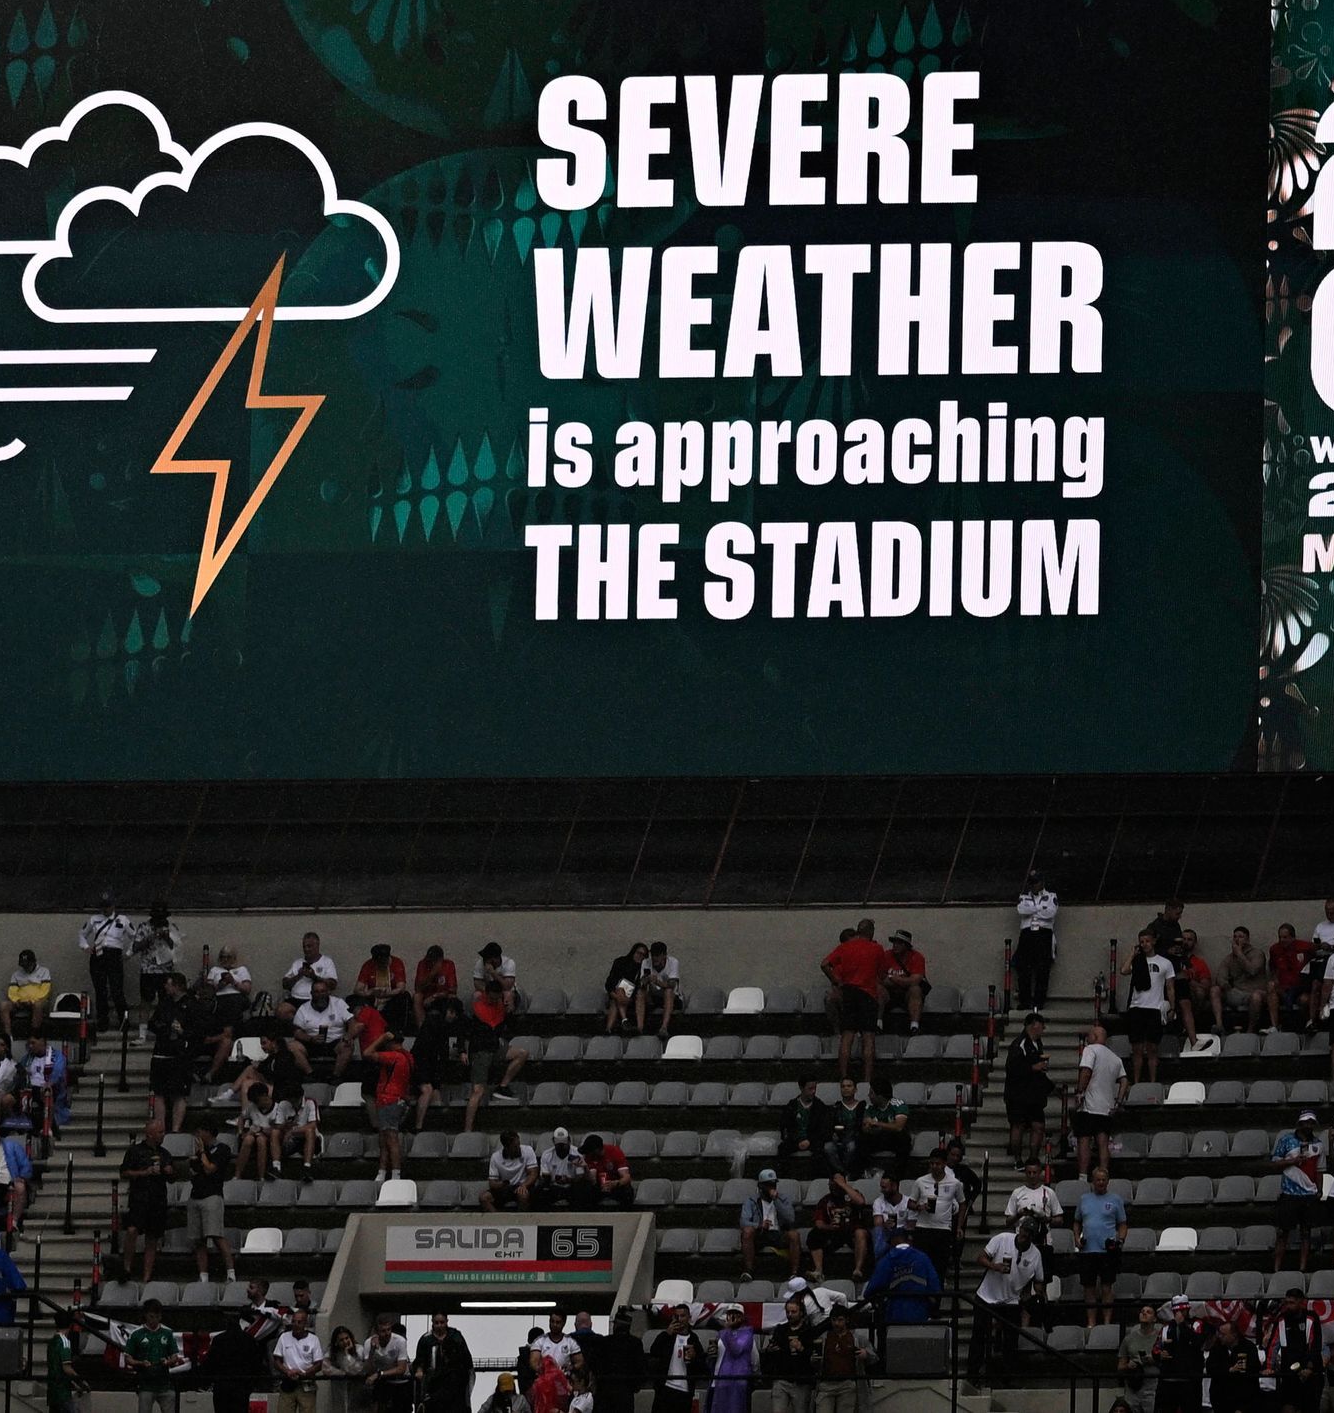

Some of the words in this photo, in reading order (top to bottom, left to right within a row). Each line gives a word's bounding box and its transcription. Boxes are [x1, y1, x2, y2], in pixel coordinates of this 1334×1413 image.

[537, 72, 981, 211] SEVERE
[534, 242, 1105, 379] WEATHER
[528, 408, 593, 487] is
[615, 401, 1106, 502] approaching
[525, 524, 680, 620] THE
[704, 519, 1102, 620] STADIUM
[415, 1228, 524, 1249] SALIDA
[494, 1250, 523, 1258] EXIT
[551, 1228, 600, 1258] 65
